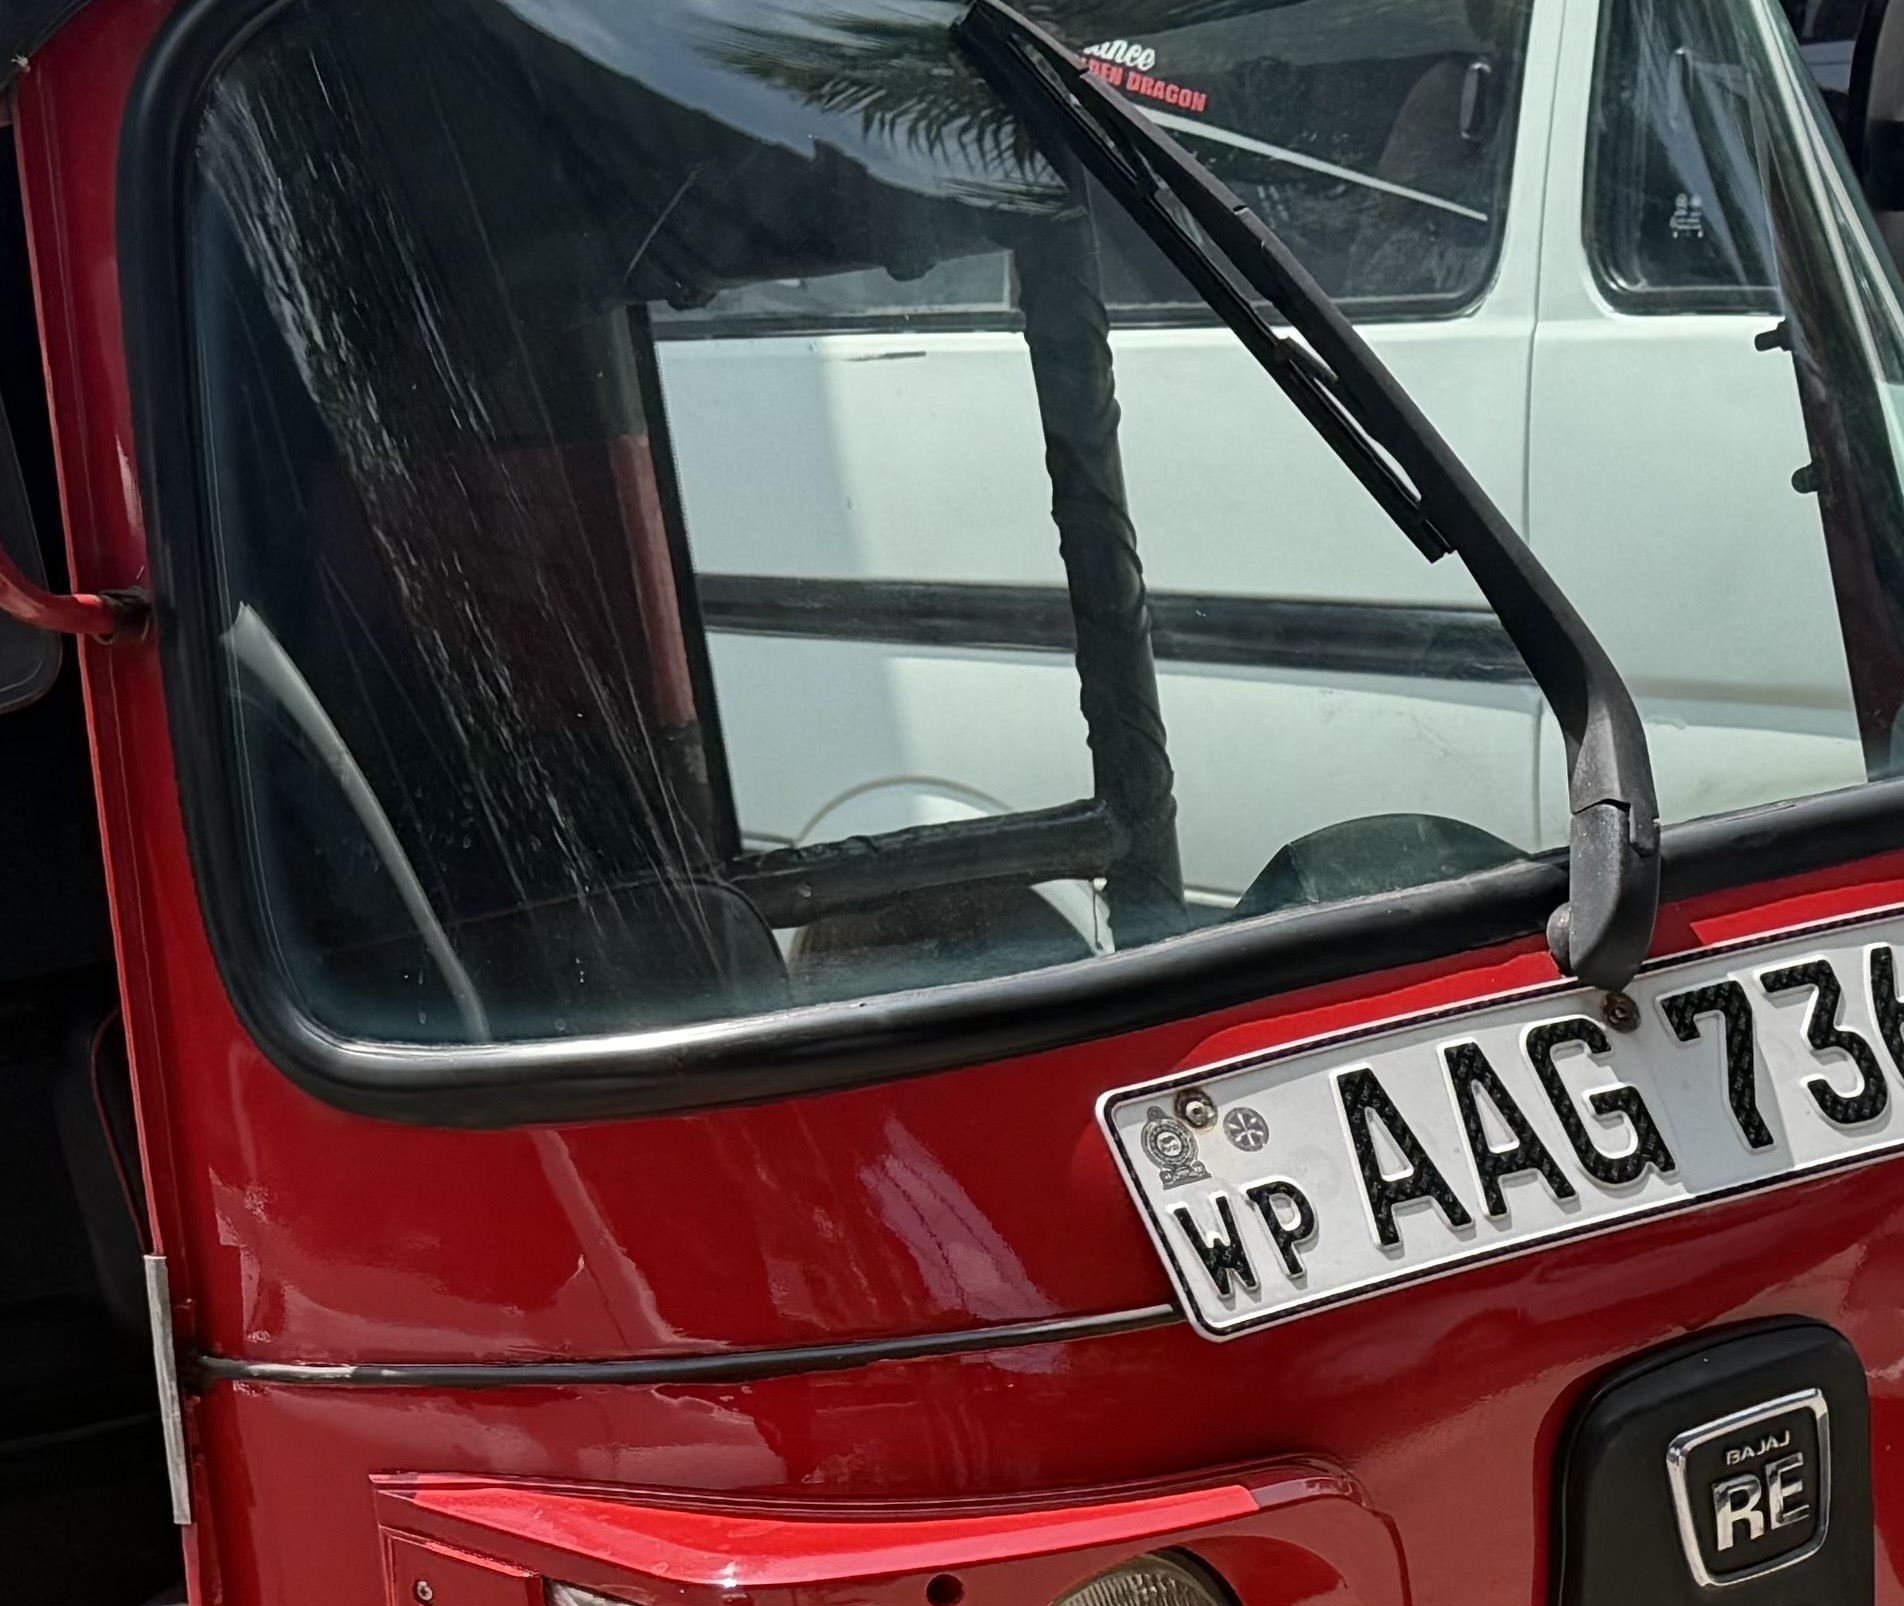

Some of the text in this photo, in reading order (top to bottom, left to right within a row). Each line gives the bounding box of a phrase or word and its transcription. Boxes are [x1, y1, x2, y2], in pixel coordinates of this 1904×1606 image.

[1127, 71, 1208, 113] DRAGON
[1172, 1180, 1316, 1296] WP
[1335, 1016, 1678, 1247] AAG
[1725, 1429, 1791, 1465] BAJAJ
[1711, 1452, 1810, 1552] RE
